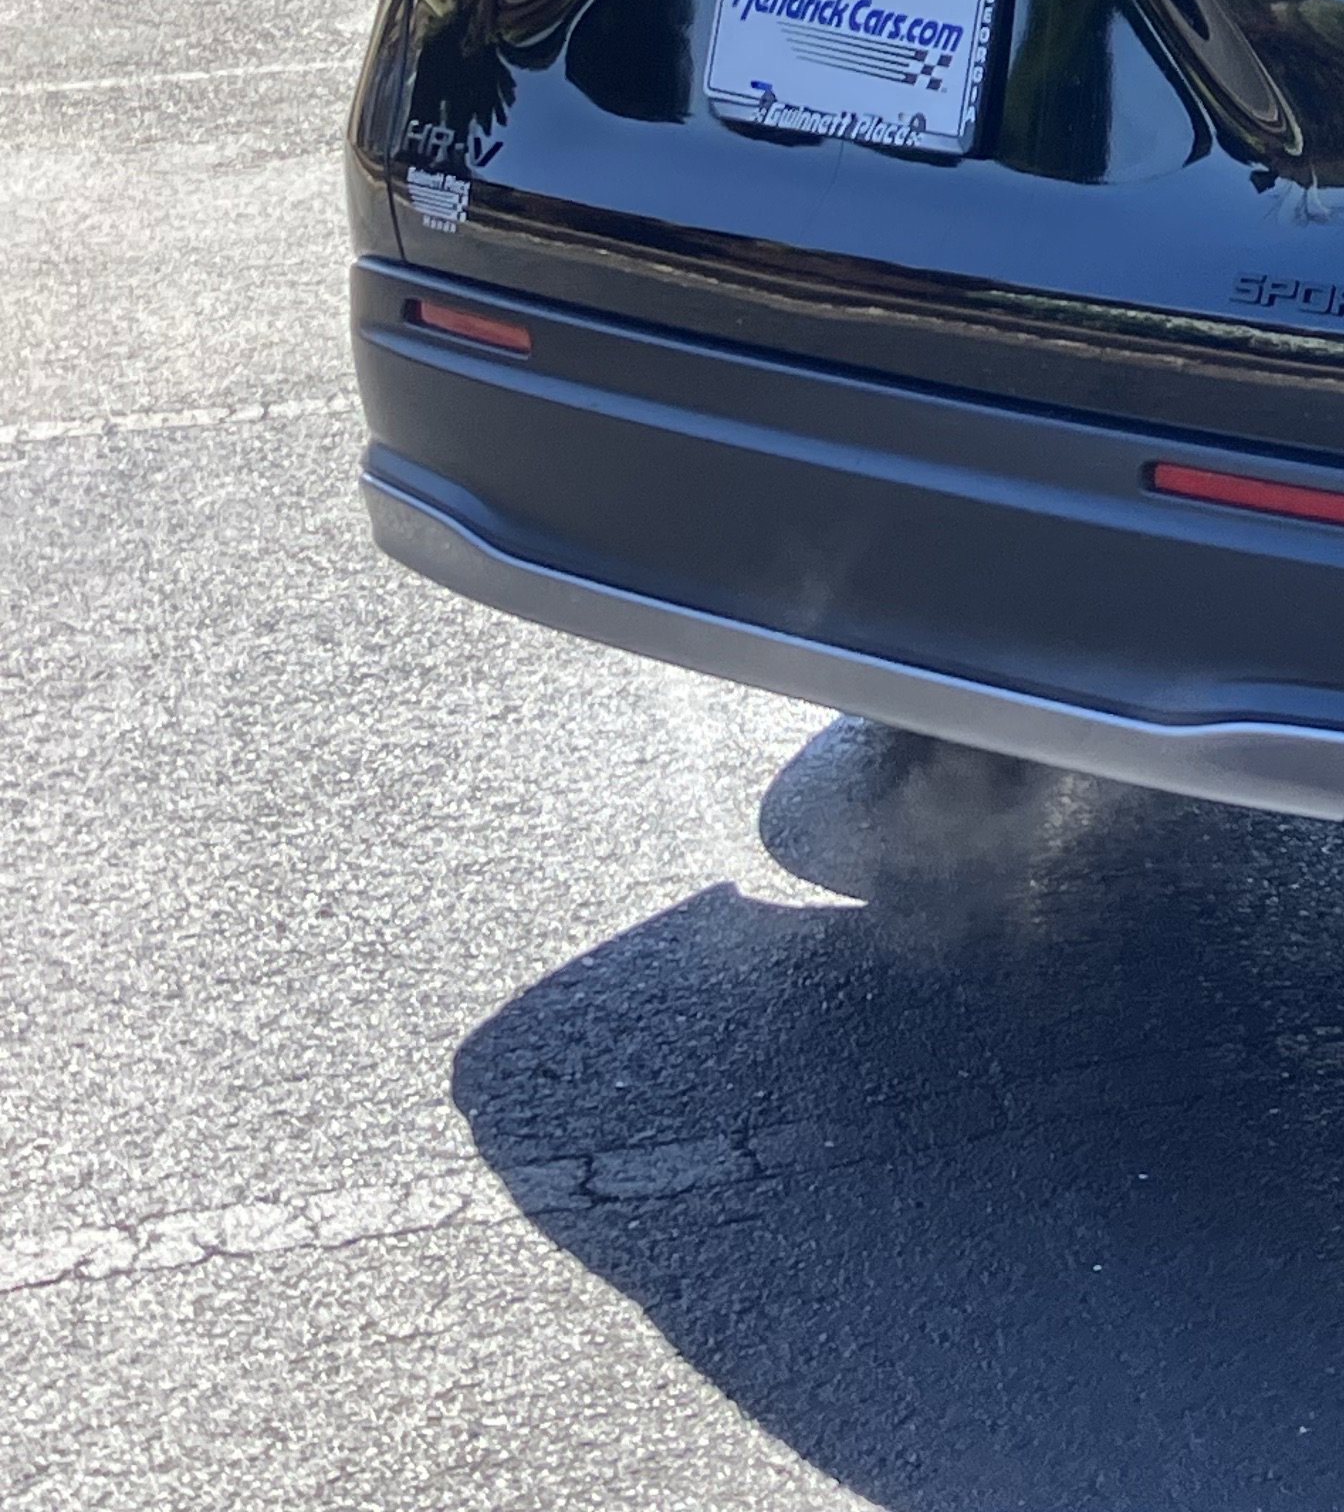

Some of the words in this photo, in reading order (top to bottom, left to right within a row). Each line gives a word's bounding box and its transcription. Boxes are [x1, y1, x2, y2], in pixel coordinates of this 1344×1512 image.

[402, 119, 504, 168] HR-V
[764, 101, 851, 138] Gwinnett
[851, 115, 911, 146] Place
